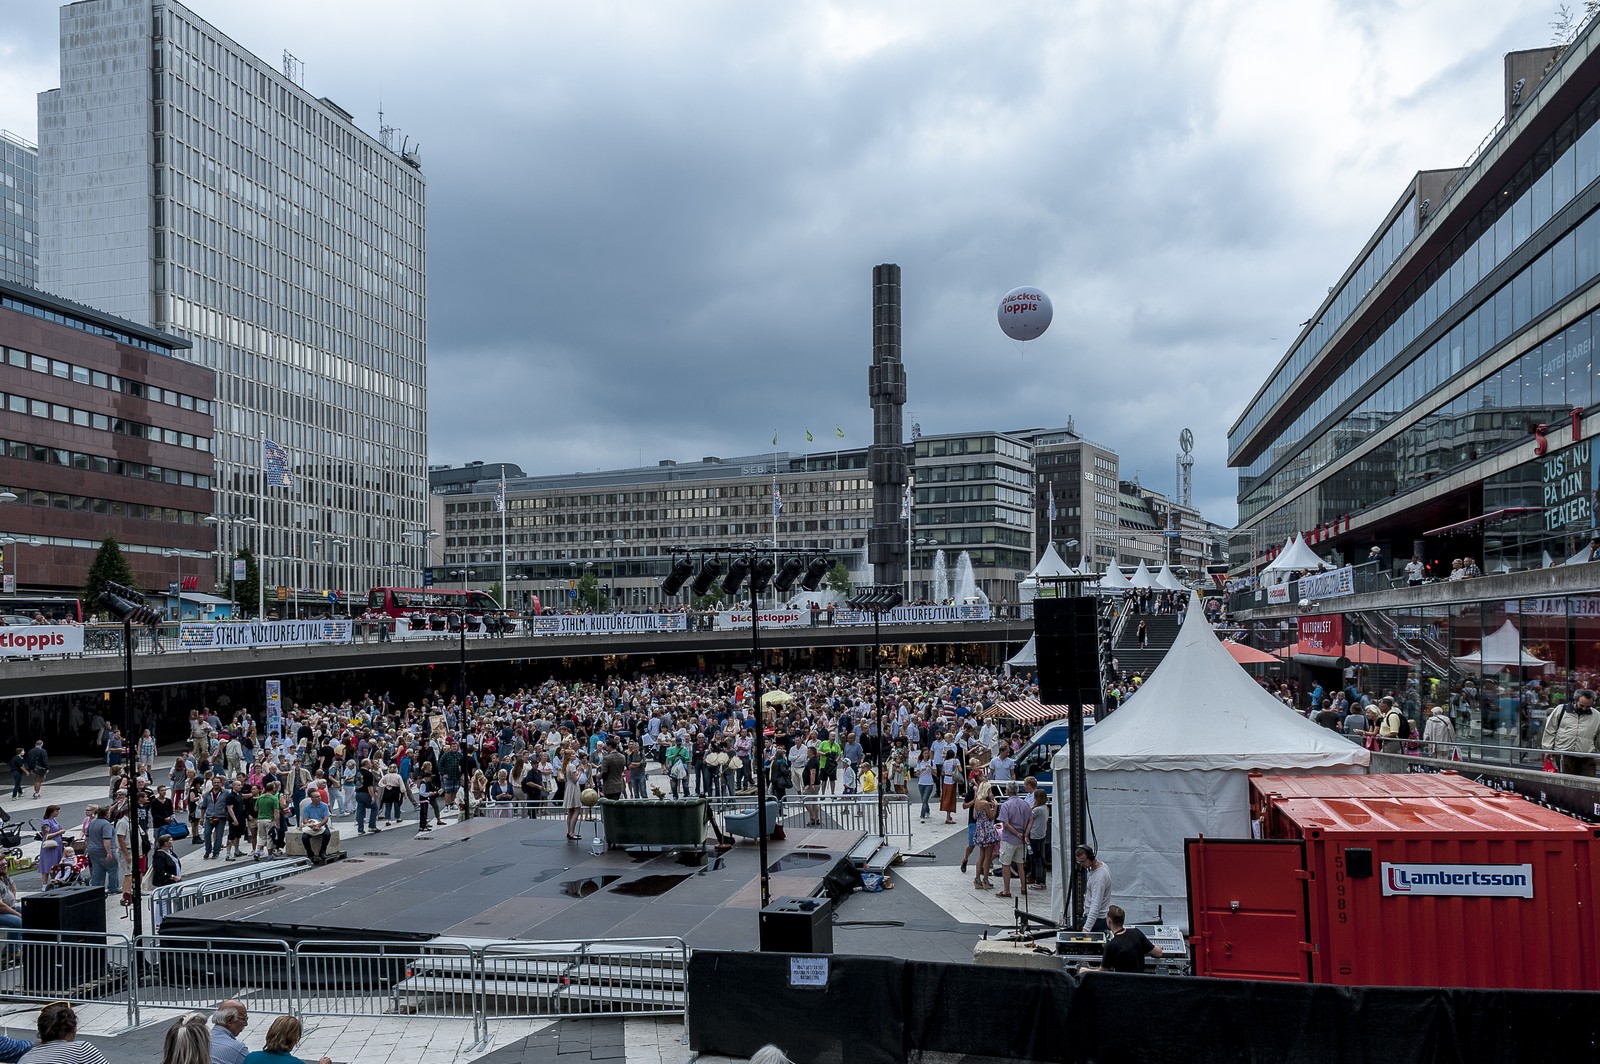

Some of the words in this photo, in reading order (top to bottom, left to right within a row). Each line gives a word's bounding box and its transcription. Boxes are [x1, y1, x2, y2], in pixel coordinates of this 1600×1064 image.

[1004, 302, 1037, 314] loppis
[1538, 336, 1595, 379] TEATERBAREN
[1543, 451, 1569, 482] JUST
[1573, 440, 1589, 467] NU
[743, 466, 763, 475] SEB
[1085, 472, 1093, 481] SEB
[1544, 482, 1557, 506] PÅ
[1561, 470, 1582, 499] DIN
[1544, 497, 1590, 530] TEATER:
[731, 613, 799, 623] blocetloppis
[891, 606, 960, 621] KULTURFESTIVAL
[591, 616, 658, 629] KULTURFESTIVAL
[251, 623, 322, 643] KULTURFESTIVAL
[1401, 871, 1527, 886] Lambertsson
